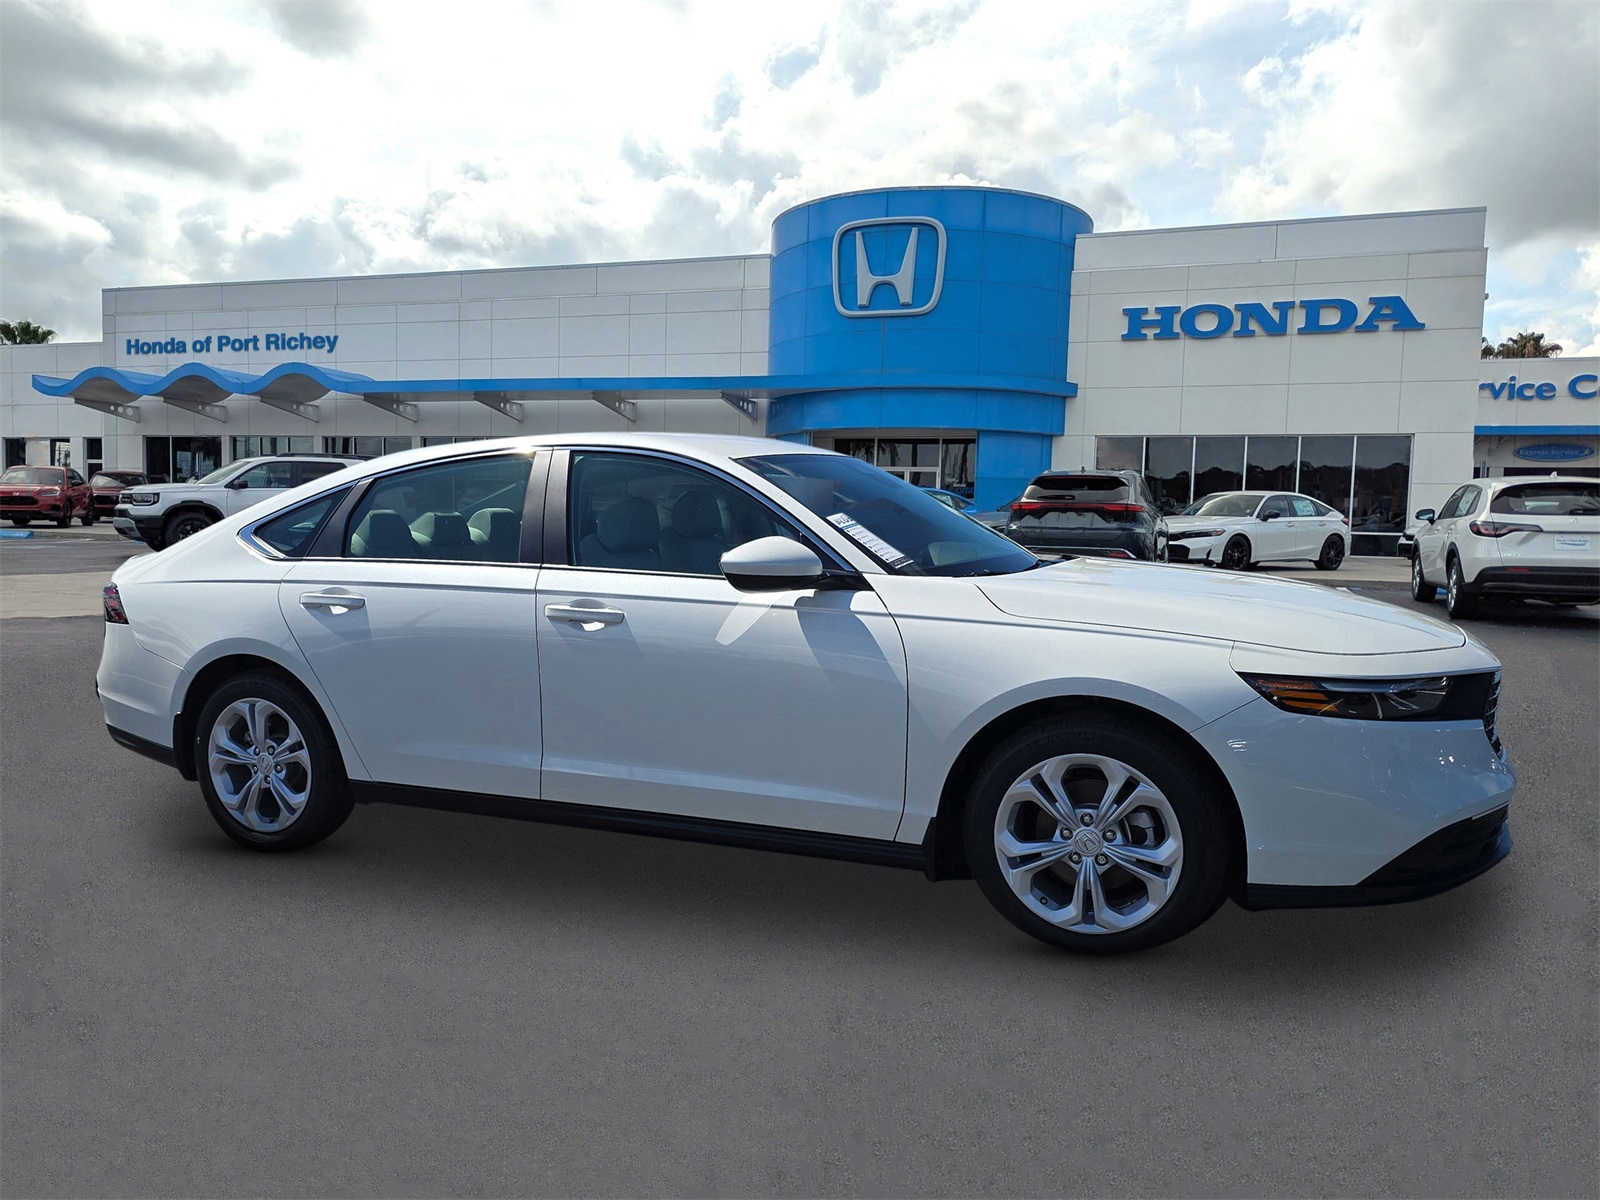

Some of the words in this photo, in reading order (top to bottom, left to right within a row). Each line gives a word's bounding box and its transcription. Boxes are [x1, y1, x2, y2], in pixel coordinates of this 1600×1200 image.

[1121, 295, 1426, 341] HONDA
[126, 337, 187, 355] Honda
[192, 335, 212, 353] of
[217, 335, 260, 352] Port
[265, 332, 339, 353] Richey
